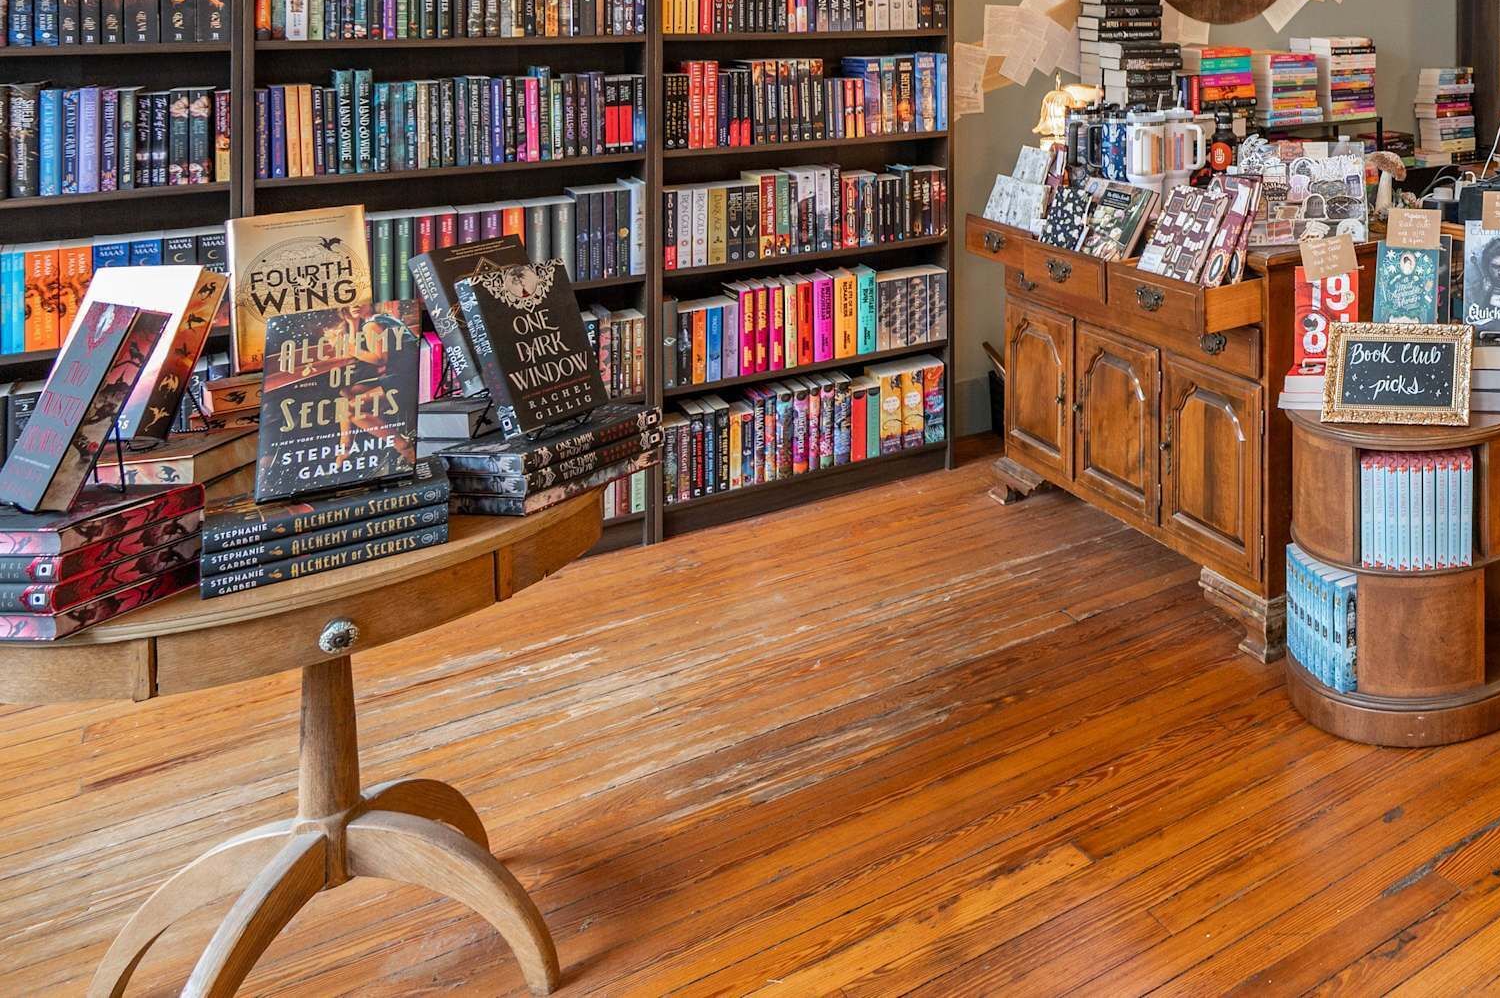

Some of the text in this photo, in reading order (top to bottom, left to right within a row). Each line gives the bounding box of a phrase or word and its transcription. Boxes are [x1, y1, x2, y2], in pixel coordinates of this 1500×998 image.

[9, 98, 23, 131] SPARROWS
[22, 99, 35, 123] SHIELD
[339, 106, 350, 126] LAND
[359, 106, 368, 126] LAND
[566, 106, 575, 140] SPELLSHOP
[580, 106, 588, 139] SPELLSHOP
[340, 127, 351, 139] SO
[359, 127, 369, 138] SO
[341, 139, 351, 161] WIDE
[360, 139, 370, 160] WIDE
[680, 194, 689, 236] IRON GOLD
[696, 193, 705, 235] IRON GOLD
[100, 249, 124, 257] MAAS
[134, 246, 158, 255] MAAS
[167, 242, 193, 250] MAAS
[202, 239, 225, 247] MAAS
[250, 259, 353, 291] FOURTH
[412, 267, 431, 301] YARROS
[419, 262, 439, 299] REBECCA
[251, 279, 357, 316] WING
[512, 308, 559, 336] ONE
[278, 325, 405, 375] ALCHEMY
[453, 345, 470, 370] ONYX
[515, 331, 570, 365] DARK
[1350, 342, 1442, 365] Book Club
[446, 346, 462, 377] STORM
[509, 351, 591, 392] WINDOW
[329, 365, 357, 388] OF
[1368, 374, 1425, 401] picks
[528, 382, 592, 410] RACHEL
[535, 395, 593, 421] GILLIG
[279, 388, 400, 433] SECRETS
[756, 407, 764, 449] IMMORTAL
[279, 439, 295, 447] NEW
[282, 435, 397, 465] STEPHANIE
[555, 432, 596, 452] ONE DARK
[299, 456, 380, 480] GARBER
[559, 451, 598, 472] ONE DARK
[213, 492, 419, 541] STEPHANIE ALCHEMY OF SECRETS
[211, 514, 417, 564] STEPHANIE ALCHEMY OF SECRETS
[222, 534, 261, 549] GARBER
[210, 536, 417, 588] STEPHANIE ALCHEMY OF SECRETS
[219, 556, 258, 571] GARBER
[218, 580, 257, 595] GARBER
